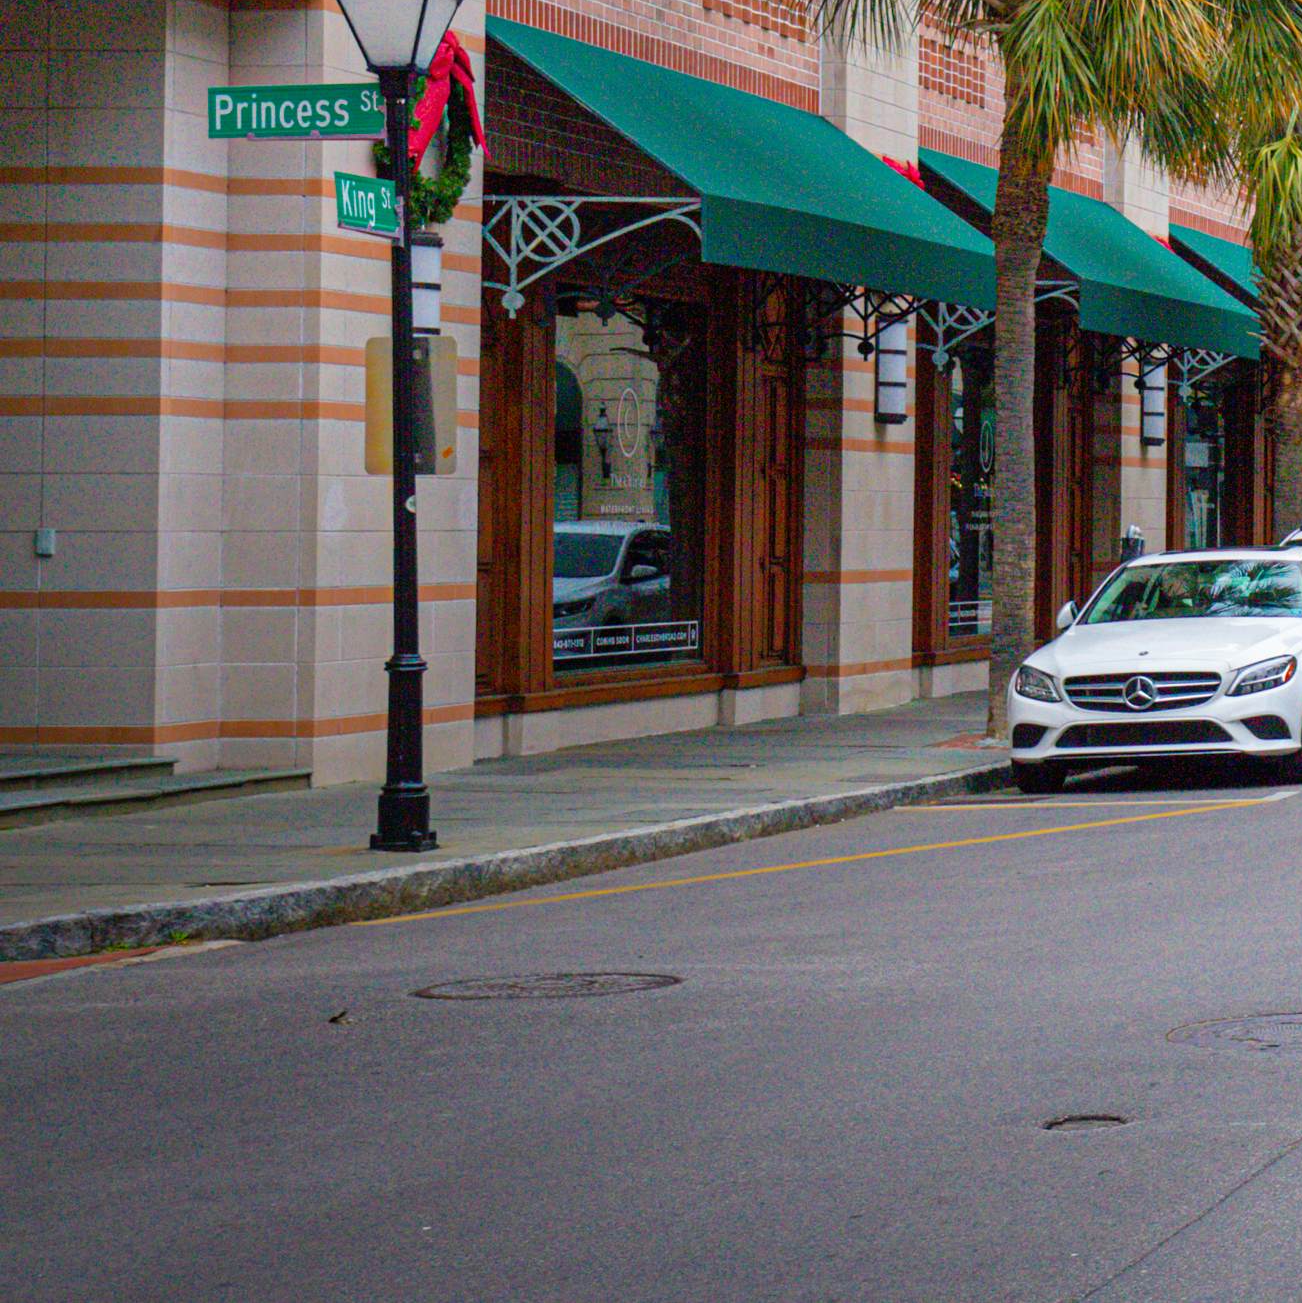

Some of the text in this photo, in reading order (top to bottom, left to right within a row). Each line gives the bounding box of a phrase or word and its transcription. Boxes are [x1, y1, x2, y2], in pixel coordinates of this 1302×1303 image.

[214, 90, 379, 131] Princess St
[340, 181, 392, 228] King St
